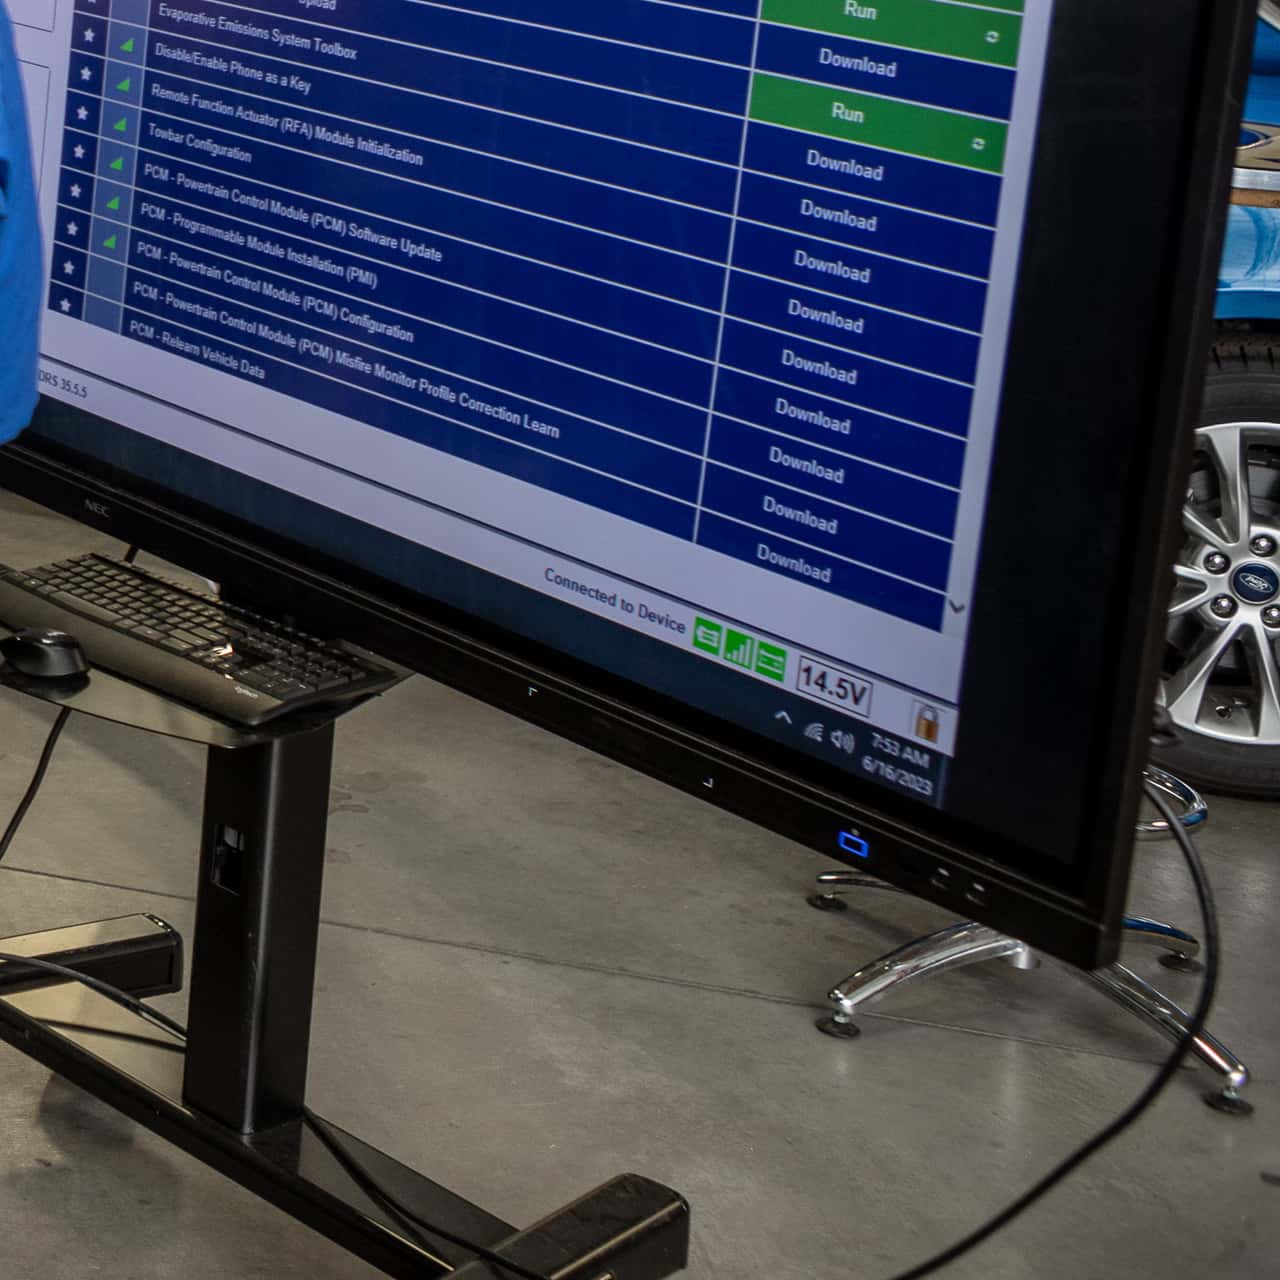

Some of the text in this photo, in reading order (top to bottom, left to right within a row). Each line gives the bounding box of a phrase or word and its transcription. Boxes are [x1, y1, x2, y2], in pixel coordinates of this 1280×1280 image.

[157, 1, 358, 60] Evaporative Emissions System Toolbox
[154, 41, 312, 96] Disable/Enable Phone as a Key
[818, 46, 897, 78] Download
[150, 82, 424, 166] Remote Function Actuator (RFA) Module Initialization
[830, 100, 865, 124] Run
[148, 121, 252, 163] Towbar Configuration
[805, 148, 884, 182] Download
[143, 162, 443, 262] PCM Powertrain Control Module (PCM) Software Update
[799, 197, 878, 232] Download
[139, 201, 378, 290] PCM Programmable Module Installation (PMI)
[793, 248, 871, 284] Download
[136, 240, 414, 343] PCM Powertrain Control Module (PCM) Configuration
[786, 297, 864, 334] Download
[128, 319, 266, 380] PCM Relearn Vehicle Data
[132, 280, 560, 439] PCM Powertrain Control Module (PCM) Misfire Monitor Profile Correction Learn
[780, 348, 858, 385] Download
[774, 396, 851, 435] Download
[768, 444, 845, 484] Download
[762, 494, 838, 535] Download
[755, 542, 832, 584] Download
[543, 566, 686, 634] Connected to Device
[802, 665, 867, 706] 14.5V
